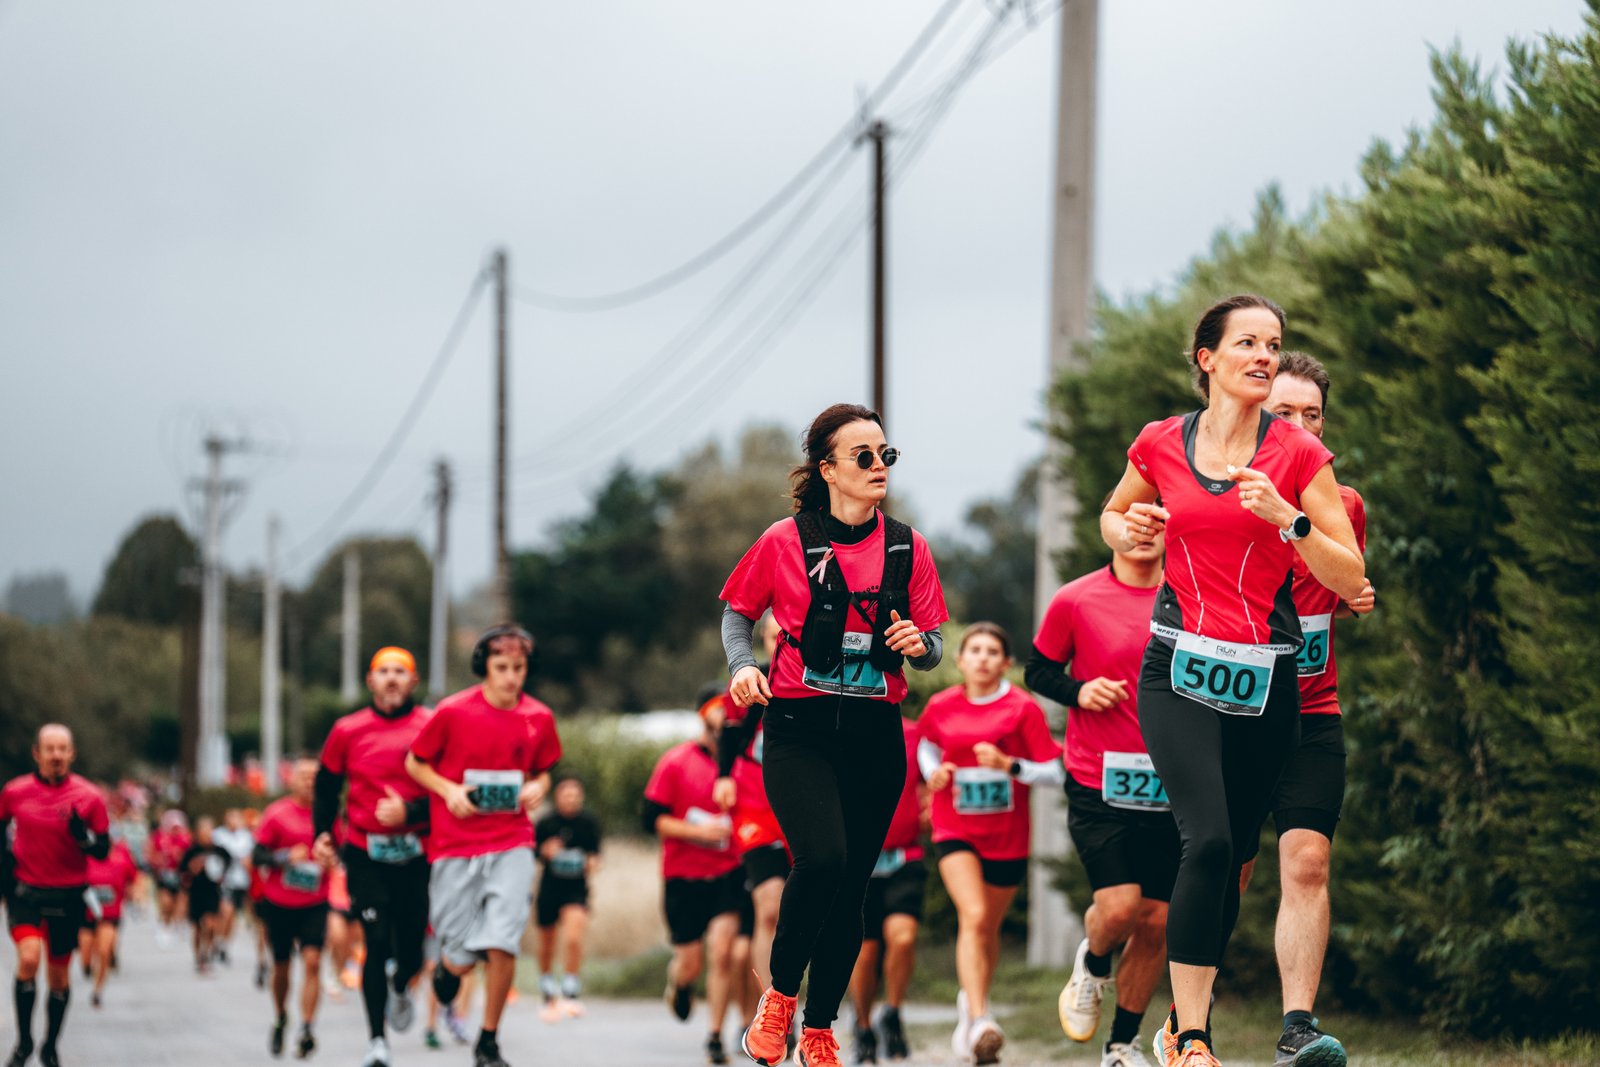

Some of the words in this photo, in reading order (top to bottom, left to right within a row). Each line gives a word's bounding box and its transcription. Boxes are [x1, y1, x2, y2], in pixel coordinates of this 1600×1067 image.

[1216, 645, 1236, 655] RUN
[1183, 656, 1256, 701] 500
[1113, 771, 1163, 798] 327
